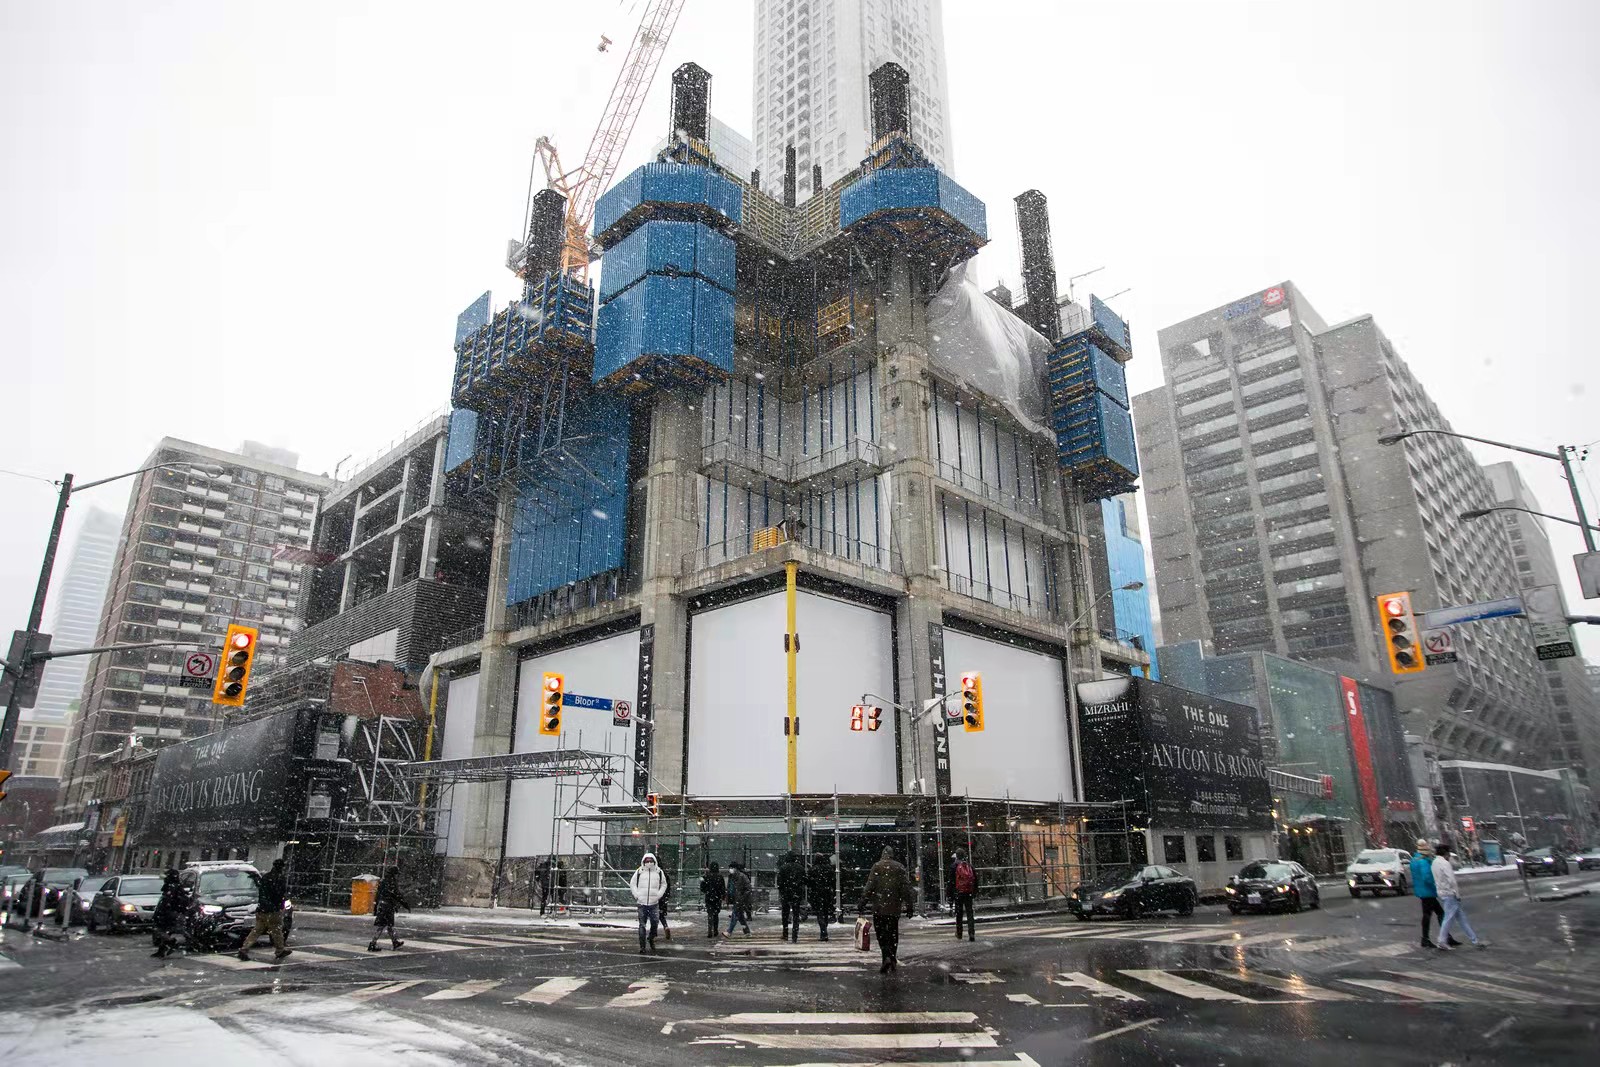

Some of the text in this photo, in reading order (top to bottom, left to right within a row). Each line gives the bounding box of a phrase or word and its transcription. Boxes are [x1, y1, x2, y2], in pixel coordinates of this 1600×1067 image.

[575, 695, 595, 706] Bloor
[1085, 702, 1129, 715] MIZRAHI
[1182, 704, 1205, 723] THE
[1208, 711, 1230, 728] ONE
[1151, 743, 1267, 779] AN ICON IS RISING
[197, 778, 211, 809] IS
[211, 769, 264, 808] RISING
